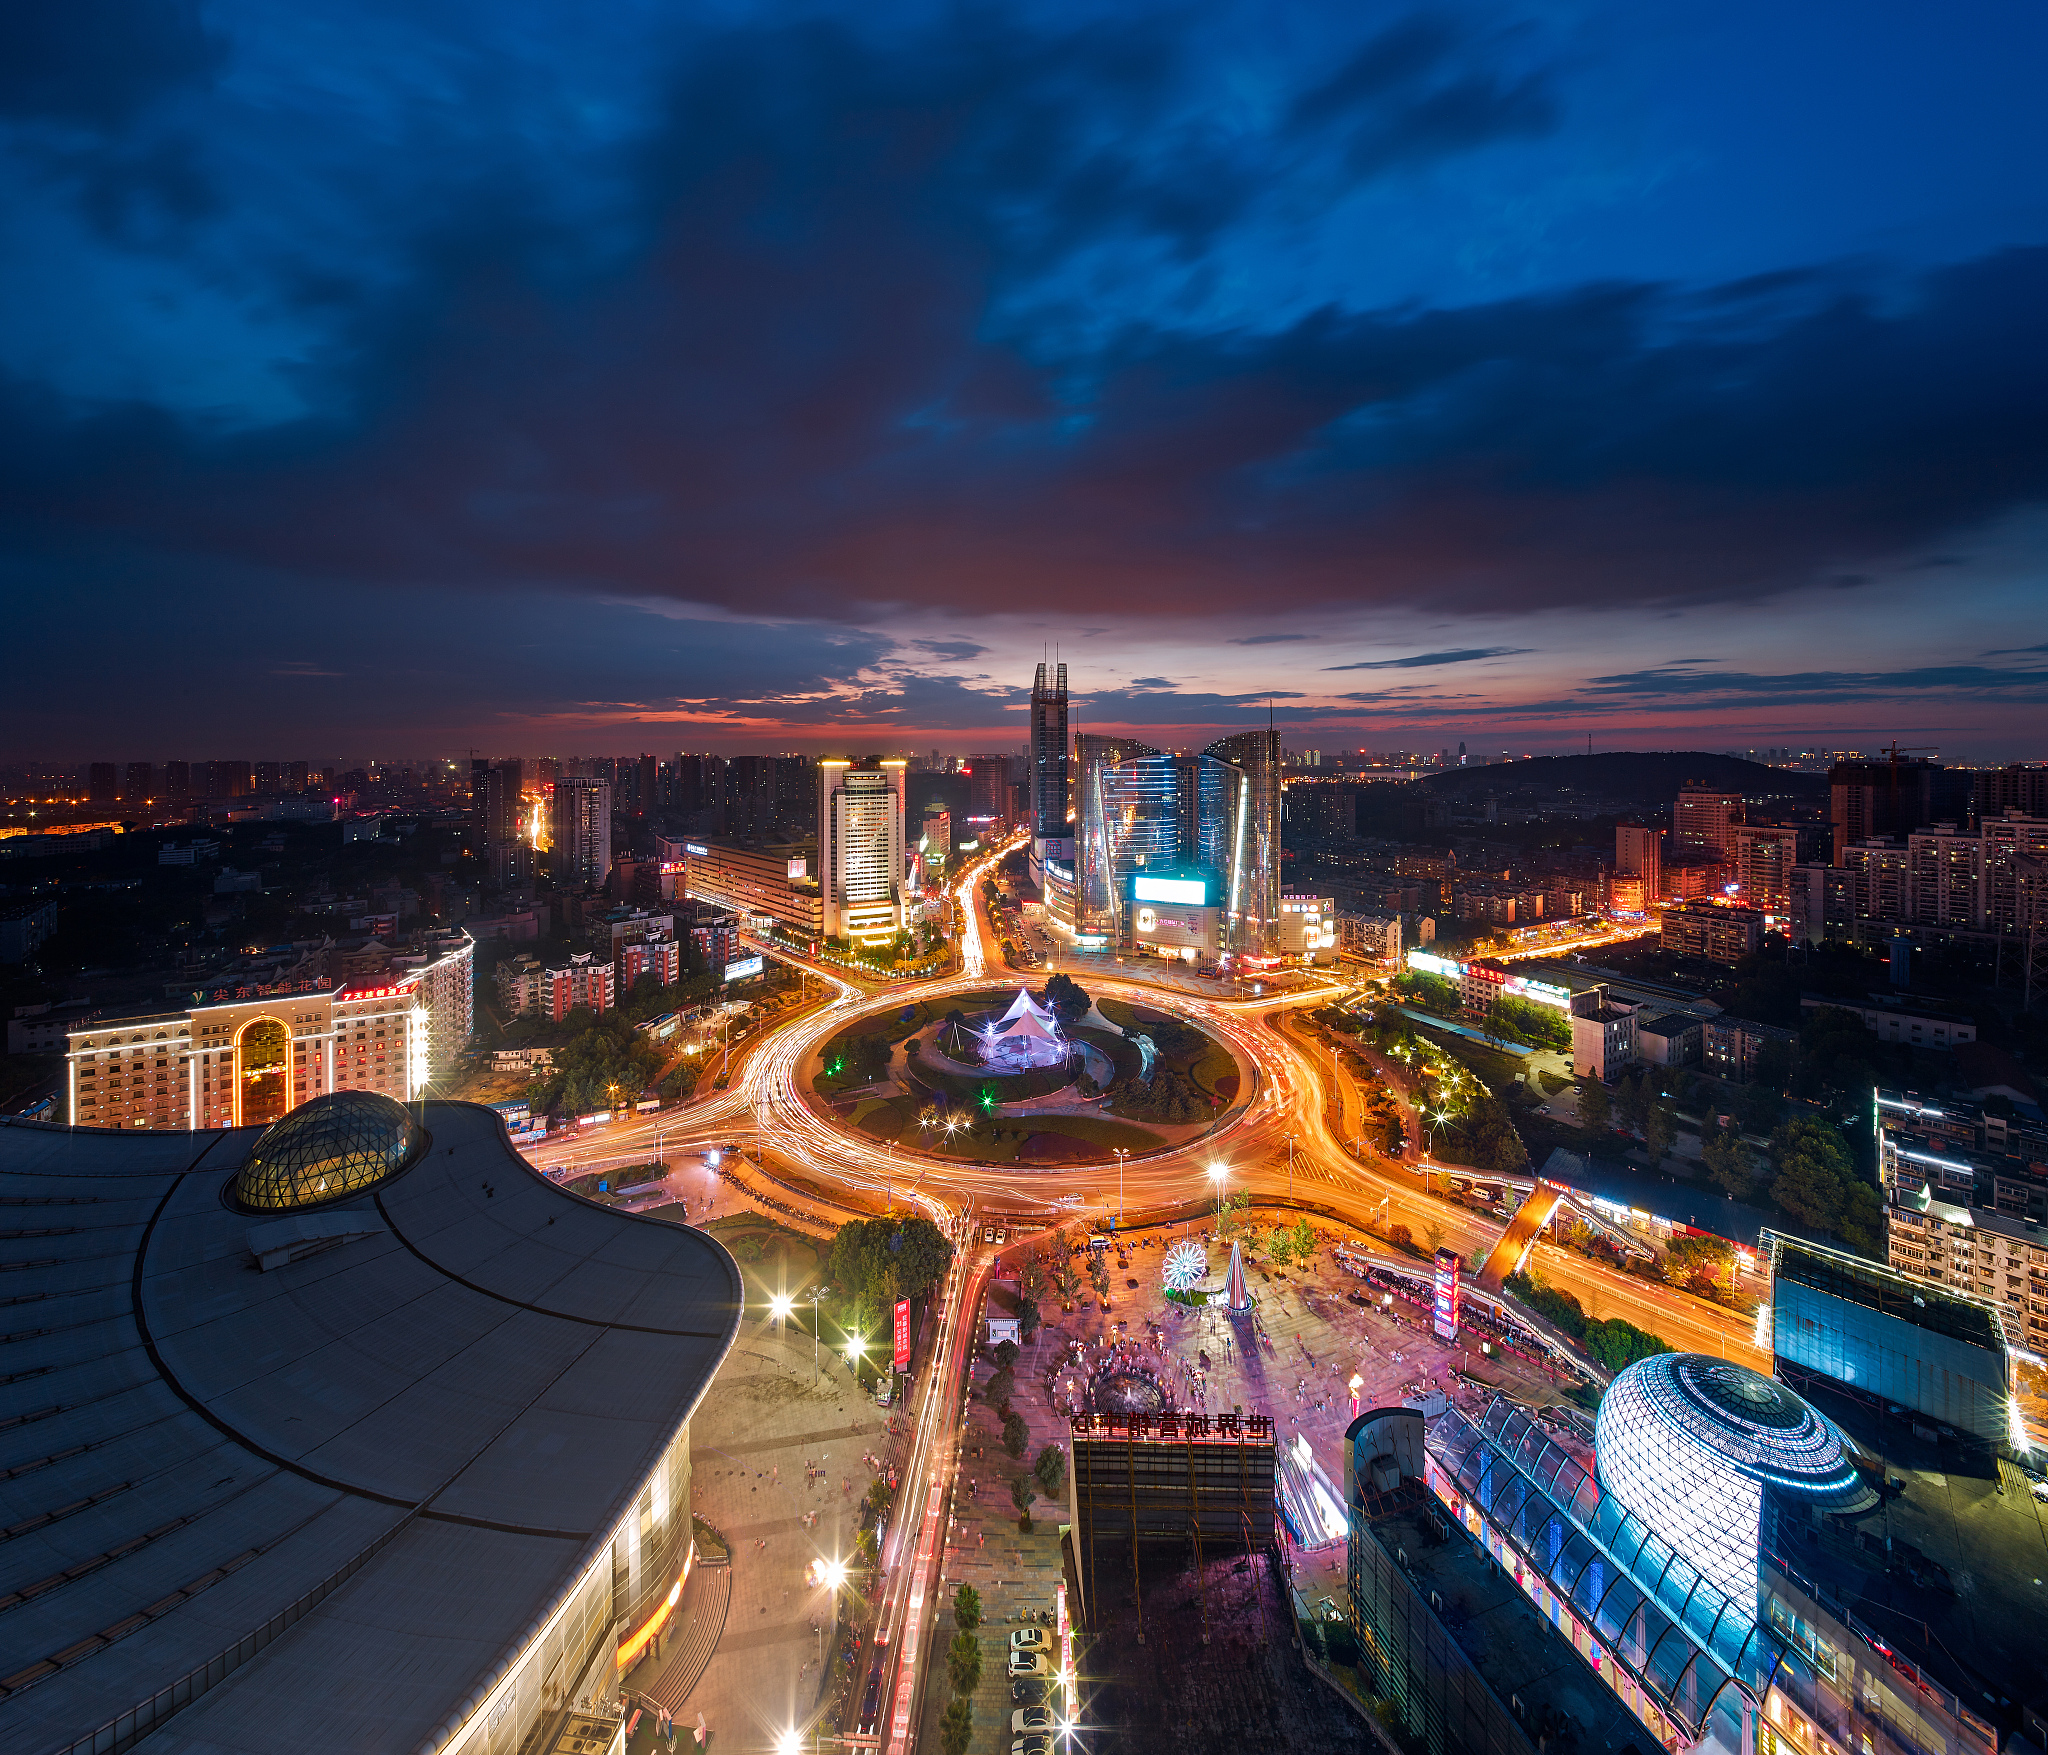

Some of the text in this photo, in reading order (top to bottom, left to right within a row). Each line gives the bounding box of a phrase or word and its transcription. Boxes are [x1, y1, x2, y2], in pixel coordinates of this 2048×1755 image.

[213, 977, 332, 1001] 尖东智能花园
